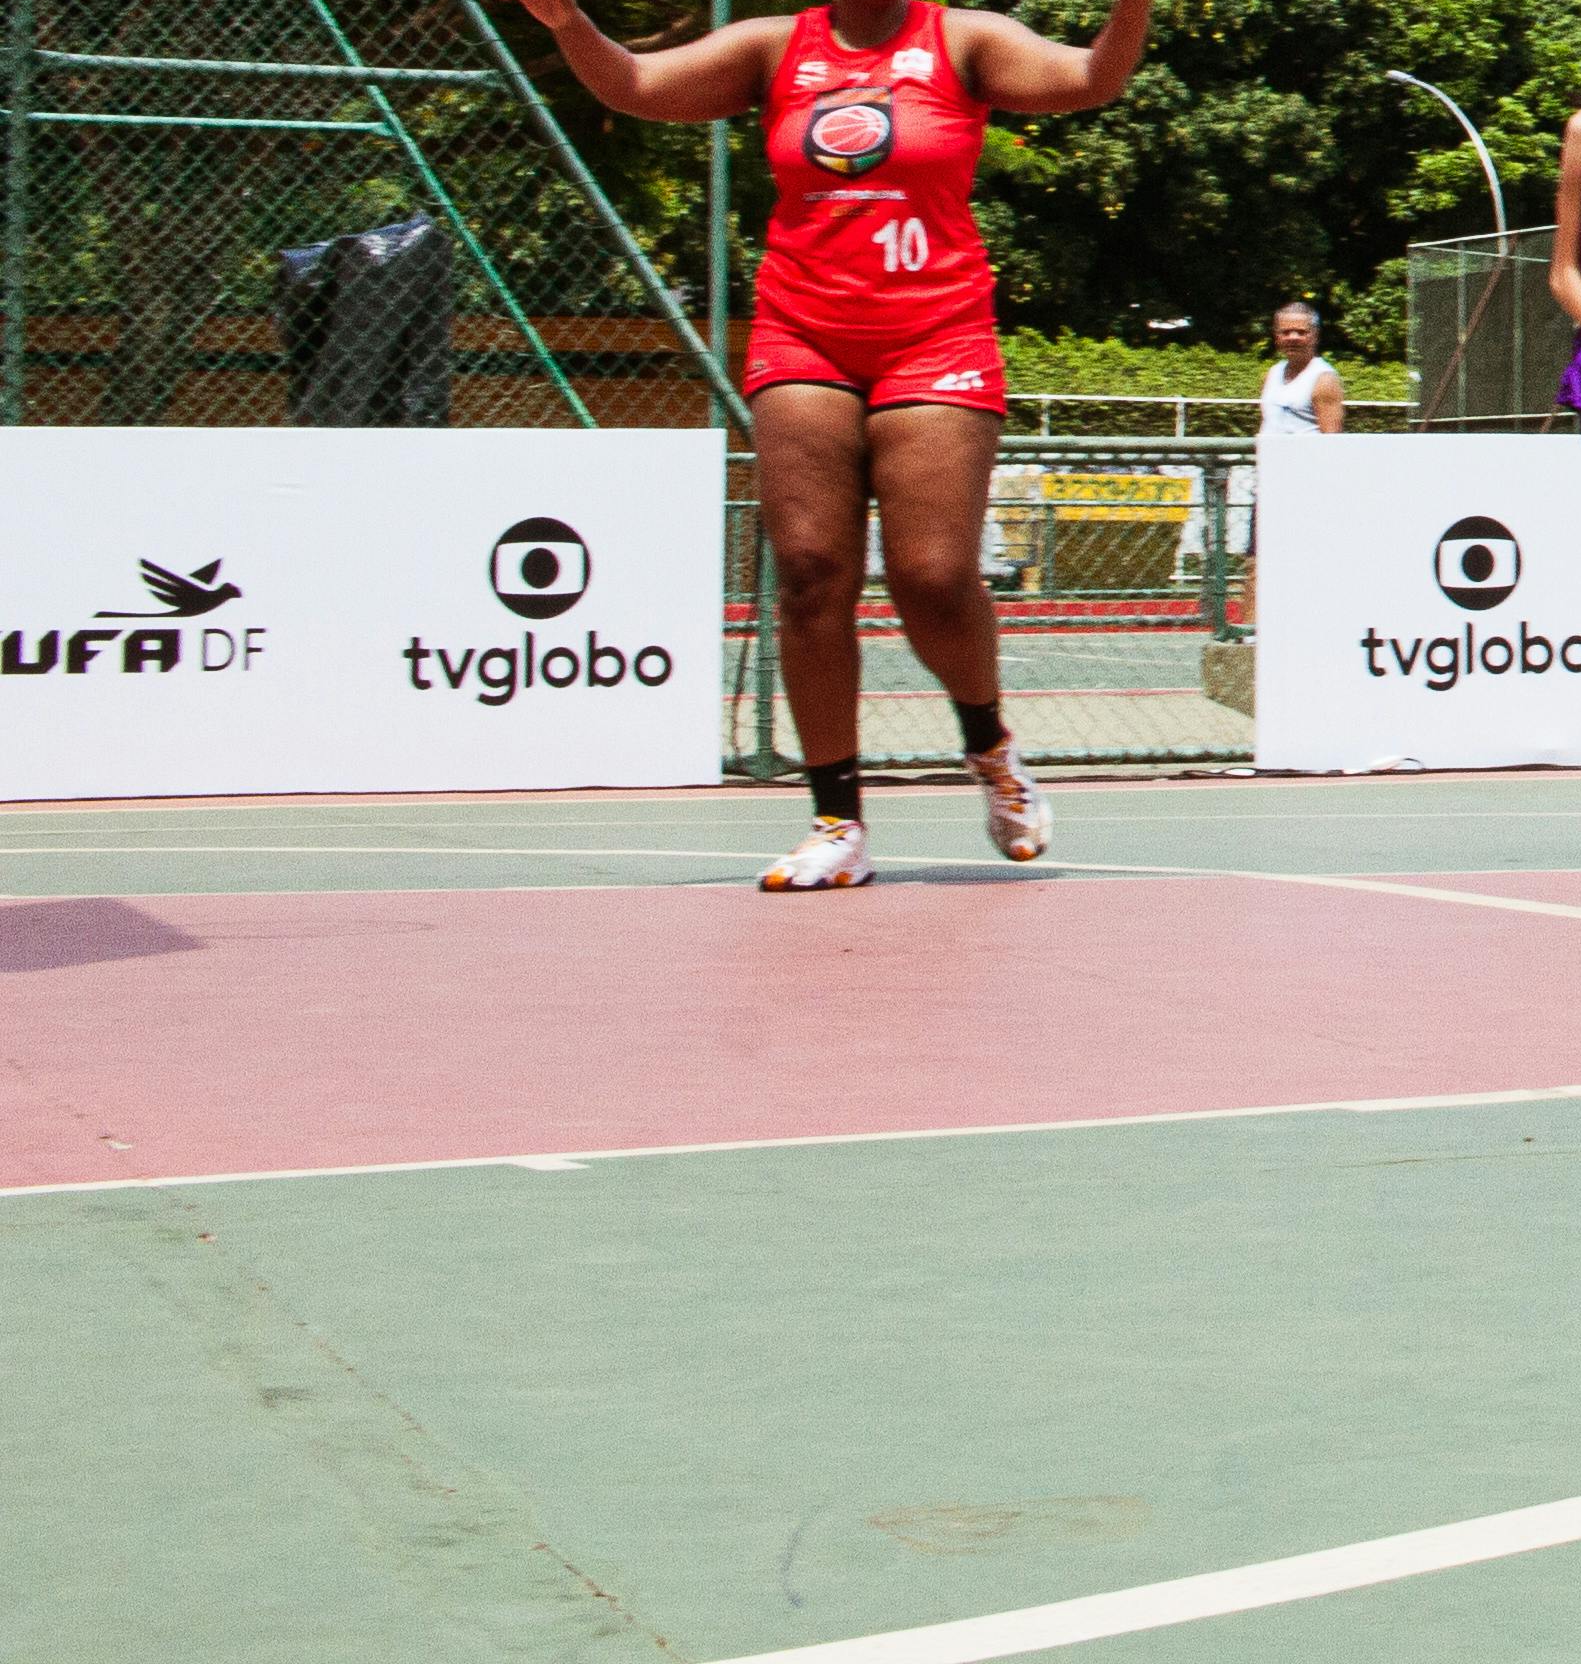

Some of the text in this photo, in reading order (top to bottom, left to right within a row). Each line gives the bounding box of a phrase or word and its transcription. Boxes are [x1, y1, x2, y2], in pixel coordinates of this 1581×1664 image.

[871, 217, 929, 272] 10
[0, 628, 267, 674] UFA DF
[403, 630, 673, 707] tvglobo
